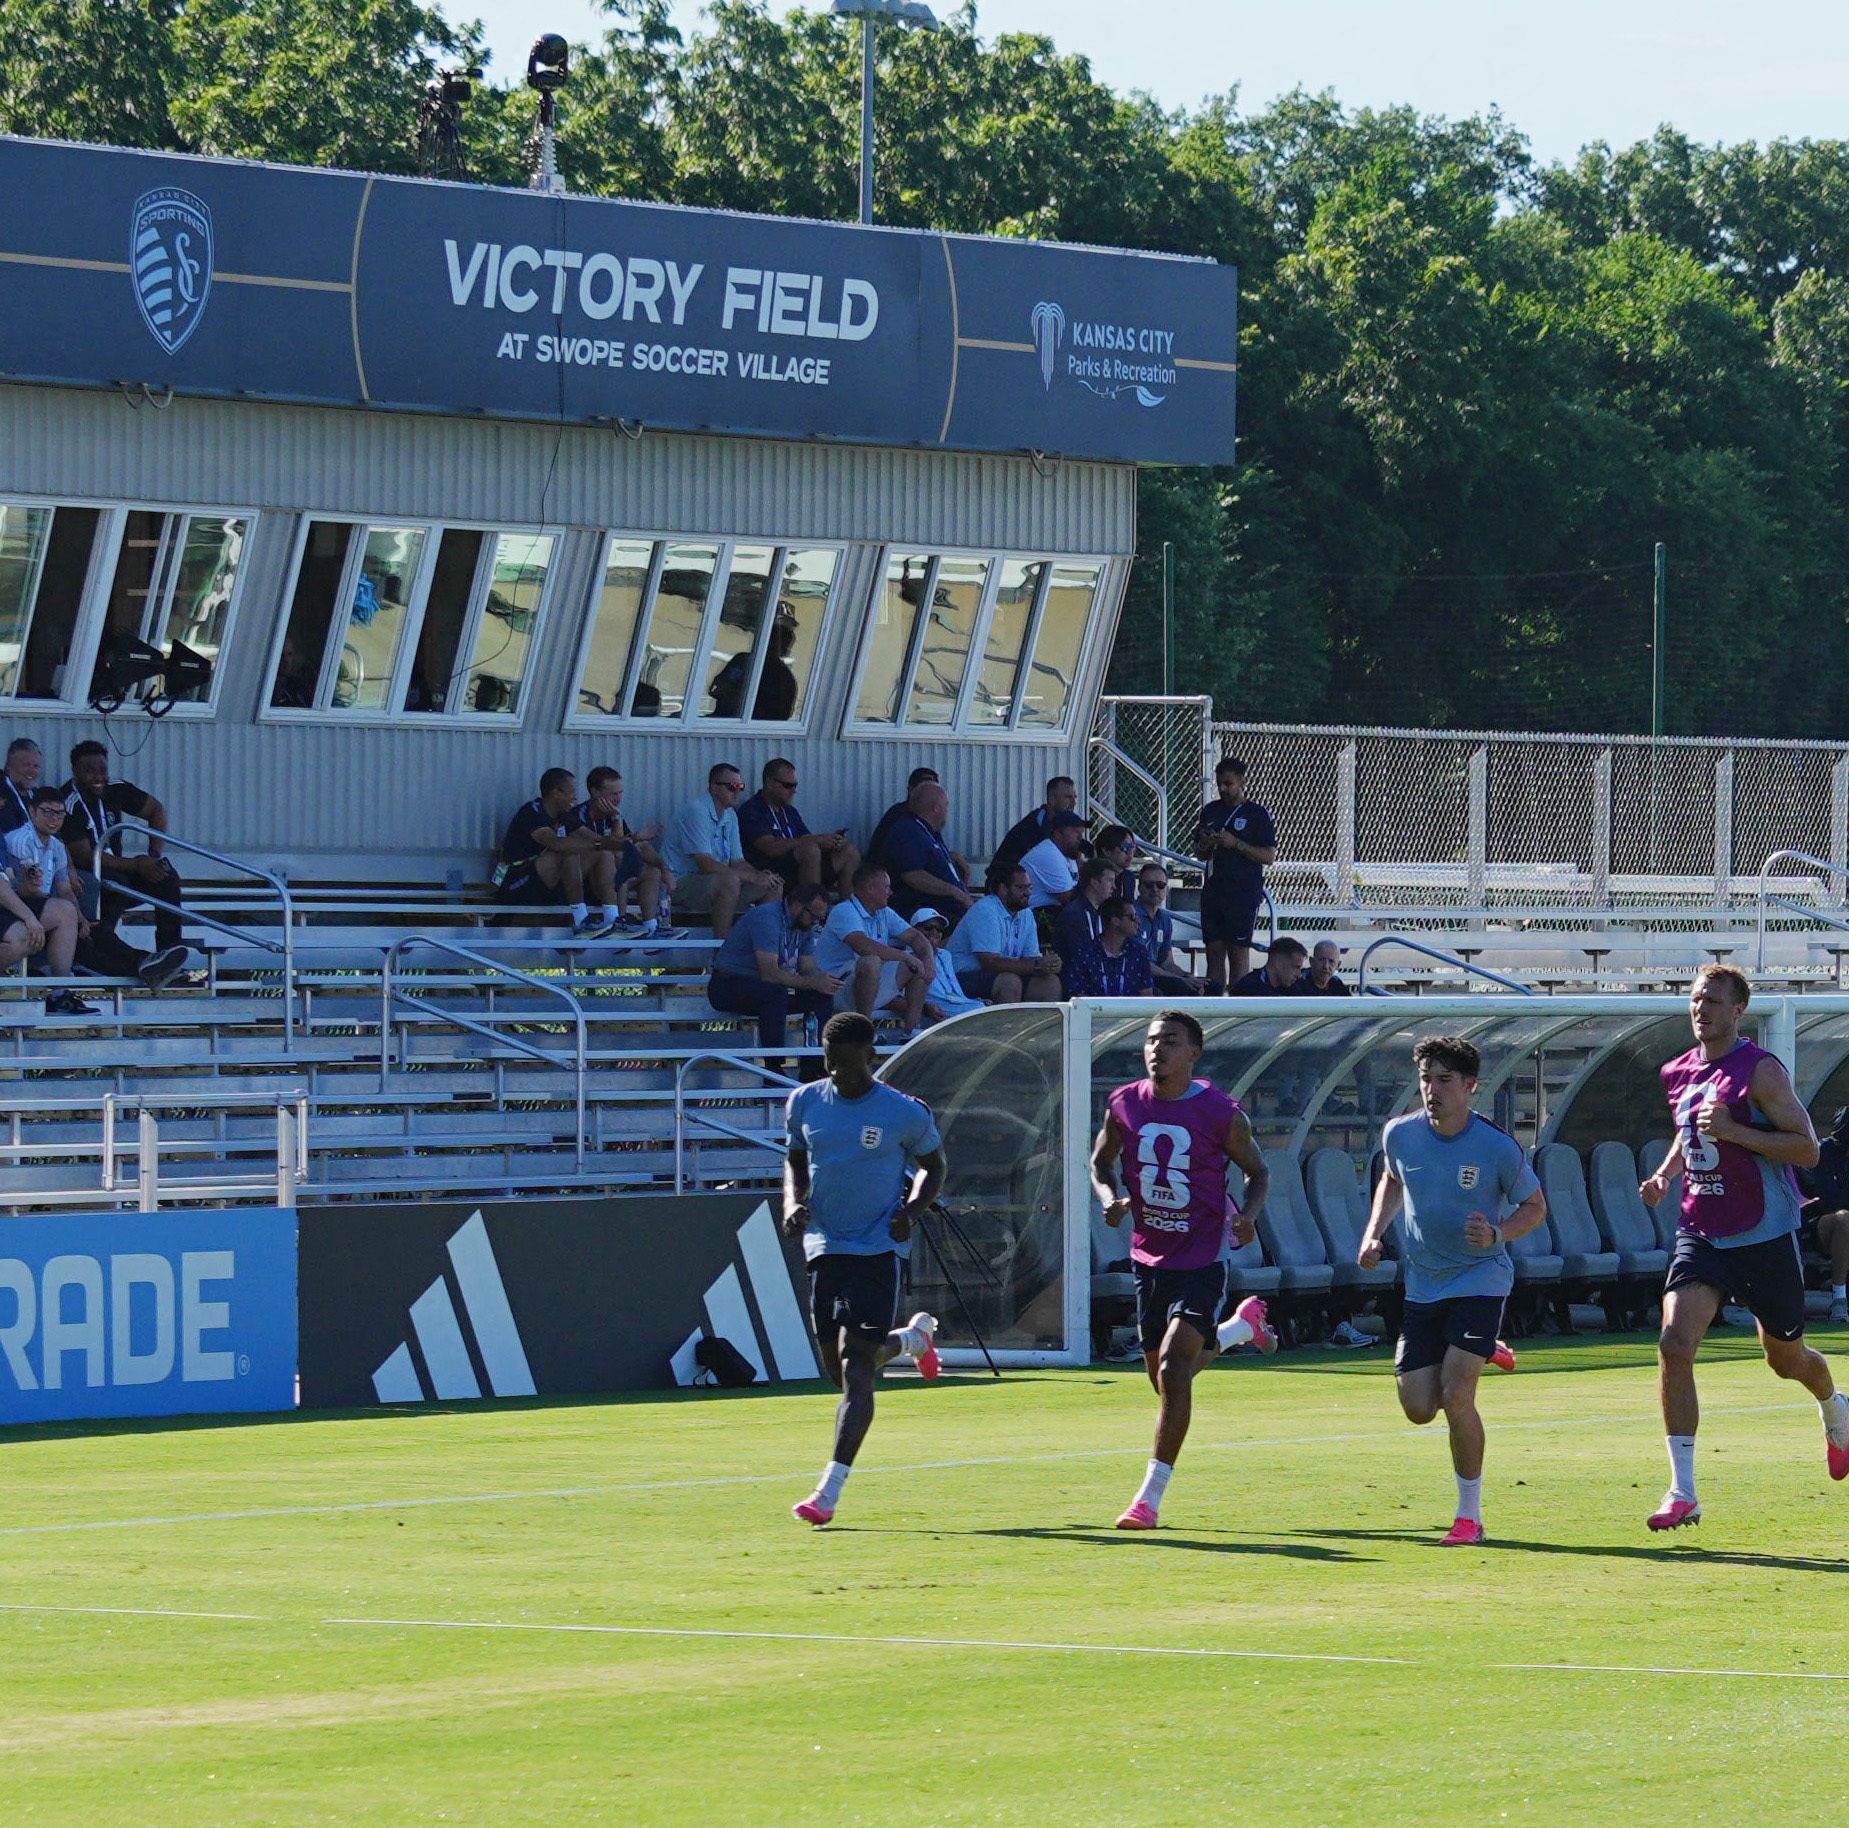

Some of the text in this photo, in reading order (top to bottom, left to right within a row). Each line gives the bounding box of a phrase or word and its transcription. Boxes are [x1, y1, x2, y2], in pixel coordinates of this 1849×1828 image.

[139, 209, 205, 238] SPORTING
[443, 239, 879, 341] VICTORY FIELD
[1073, 322, 1174, 355] KANSAS CITY
[496, 332, 831, 385] AT SWOPE SOCCER VILLAGE
[1068, 355, 1176, 385] Parks & Recreation
[1152, 1189, 1177, 1201] FIFA
[1143, 1214, 1190, 1233] 2026
